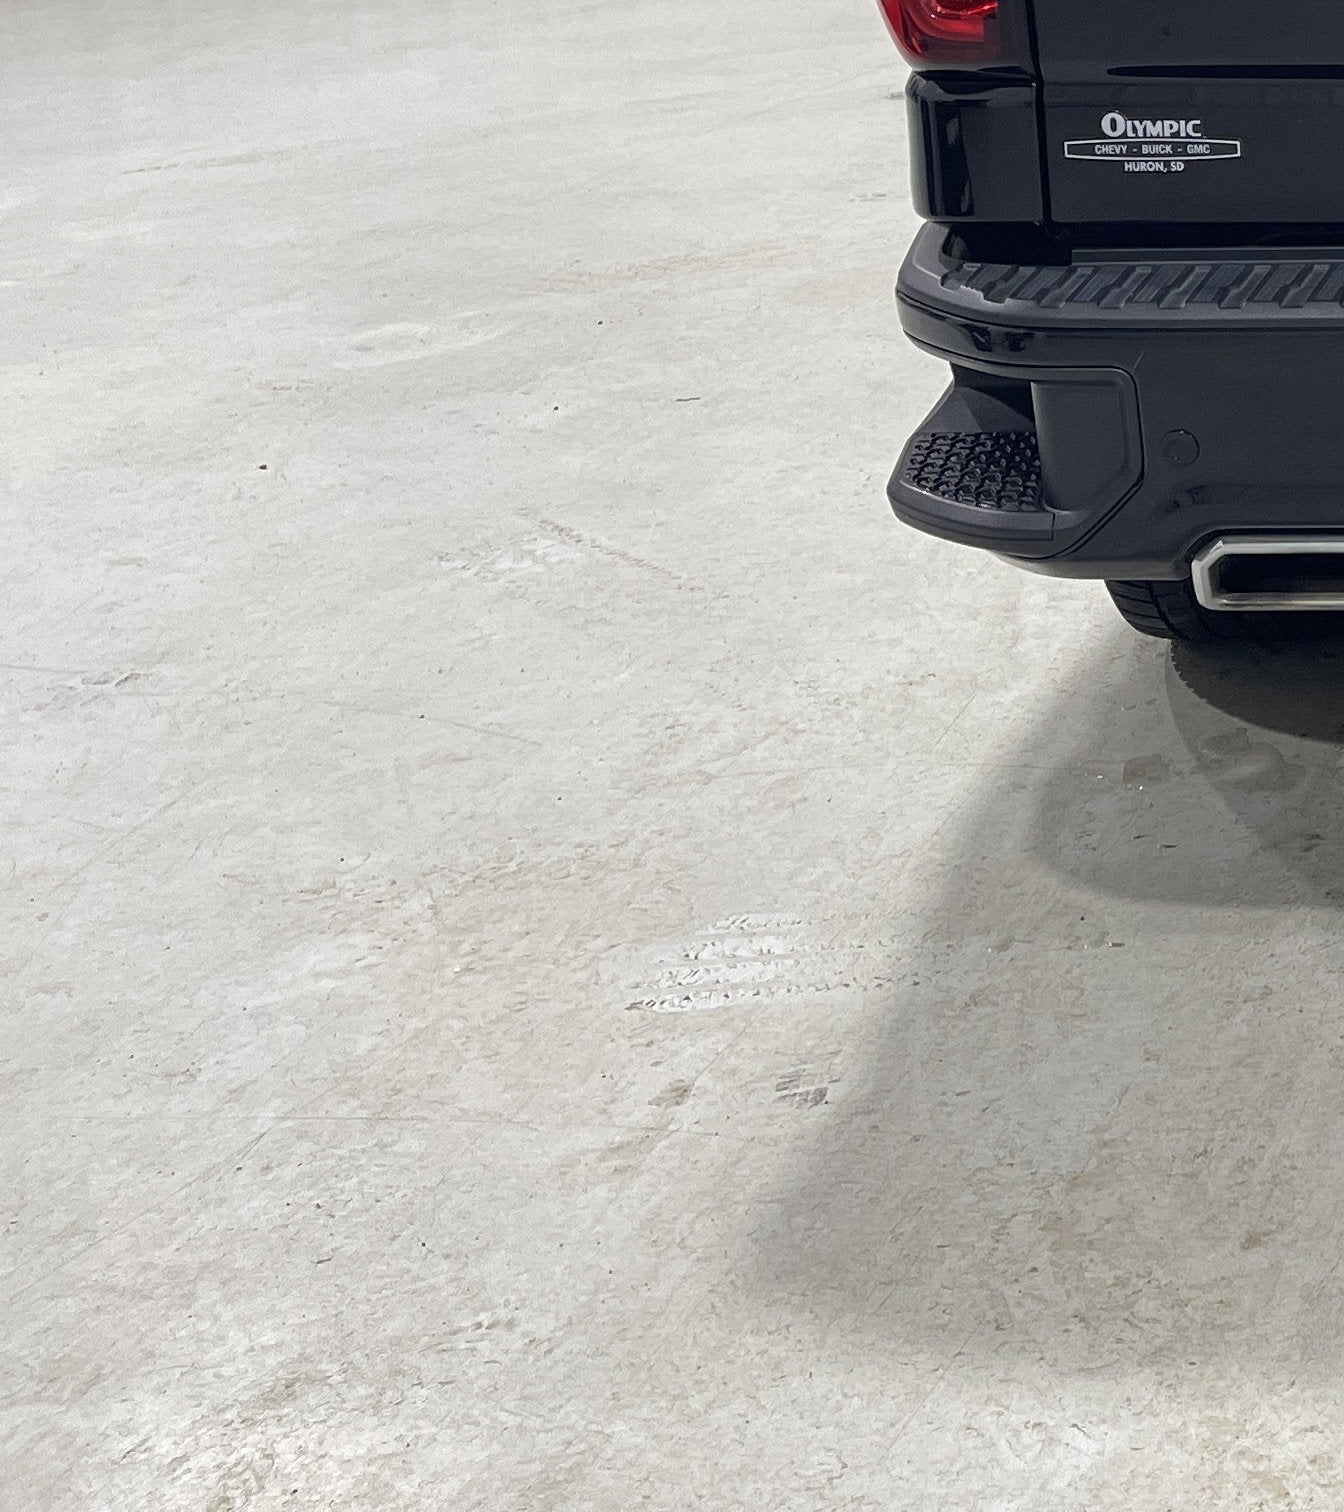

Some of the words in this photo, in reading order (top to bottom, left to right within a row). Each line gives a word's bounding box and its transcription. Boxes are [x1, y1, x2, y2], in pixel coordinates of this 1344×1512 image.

[1101, 112, 1202, 137] OLYMPIC
[1094, 144, 1127, 155] CHEVY
[1141, 144, 1173, 155] BUICK
[1186, 144, 1211, 155] GMC
[1123, 161, 1168, 173] HURON,
[1170, 161, 1185, 172] SD
